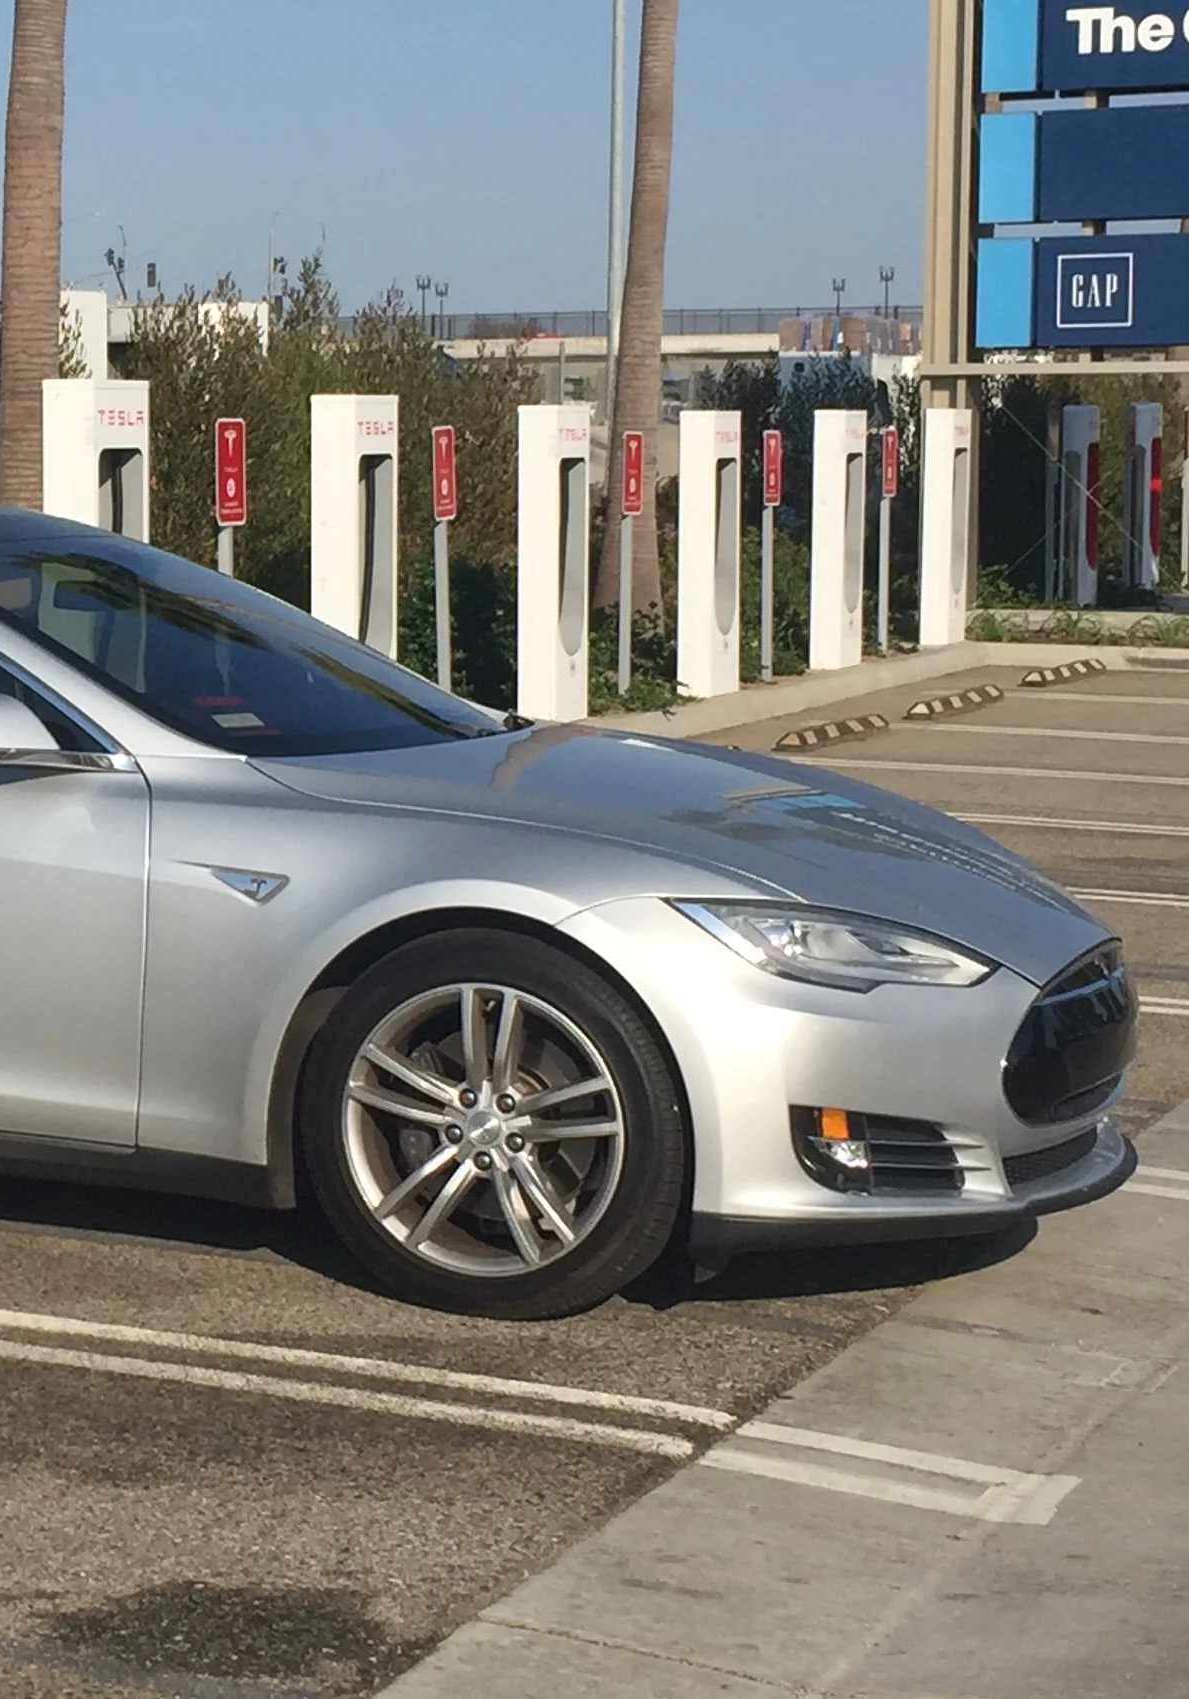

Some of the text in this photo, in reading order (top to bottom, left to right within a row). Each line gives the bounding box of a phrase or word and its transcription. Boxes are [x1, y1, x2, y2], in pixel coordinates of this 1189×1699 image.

[1066, 7, 1175, 54] The
[1072, 274, 1118, 308] GAP
[98, 409, 143, 426] TESLA
[358, 421, 393, 435] TESLA
